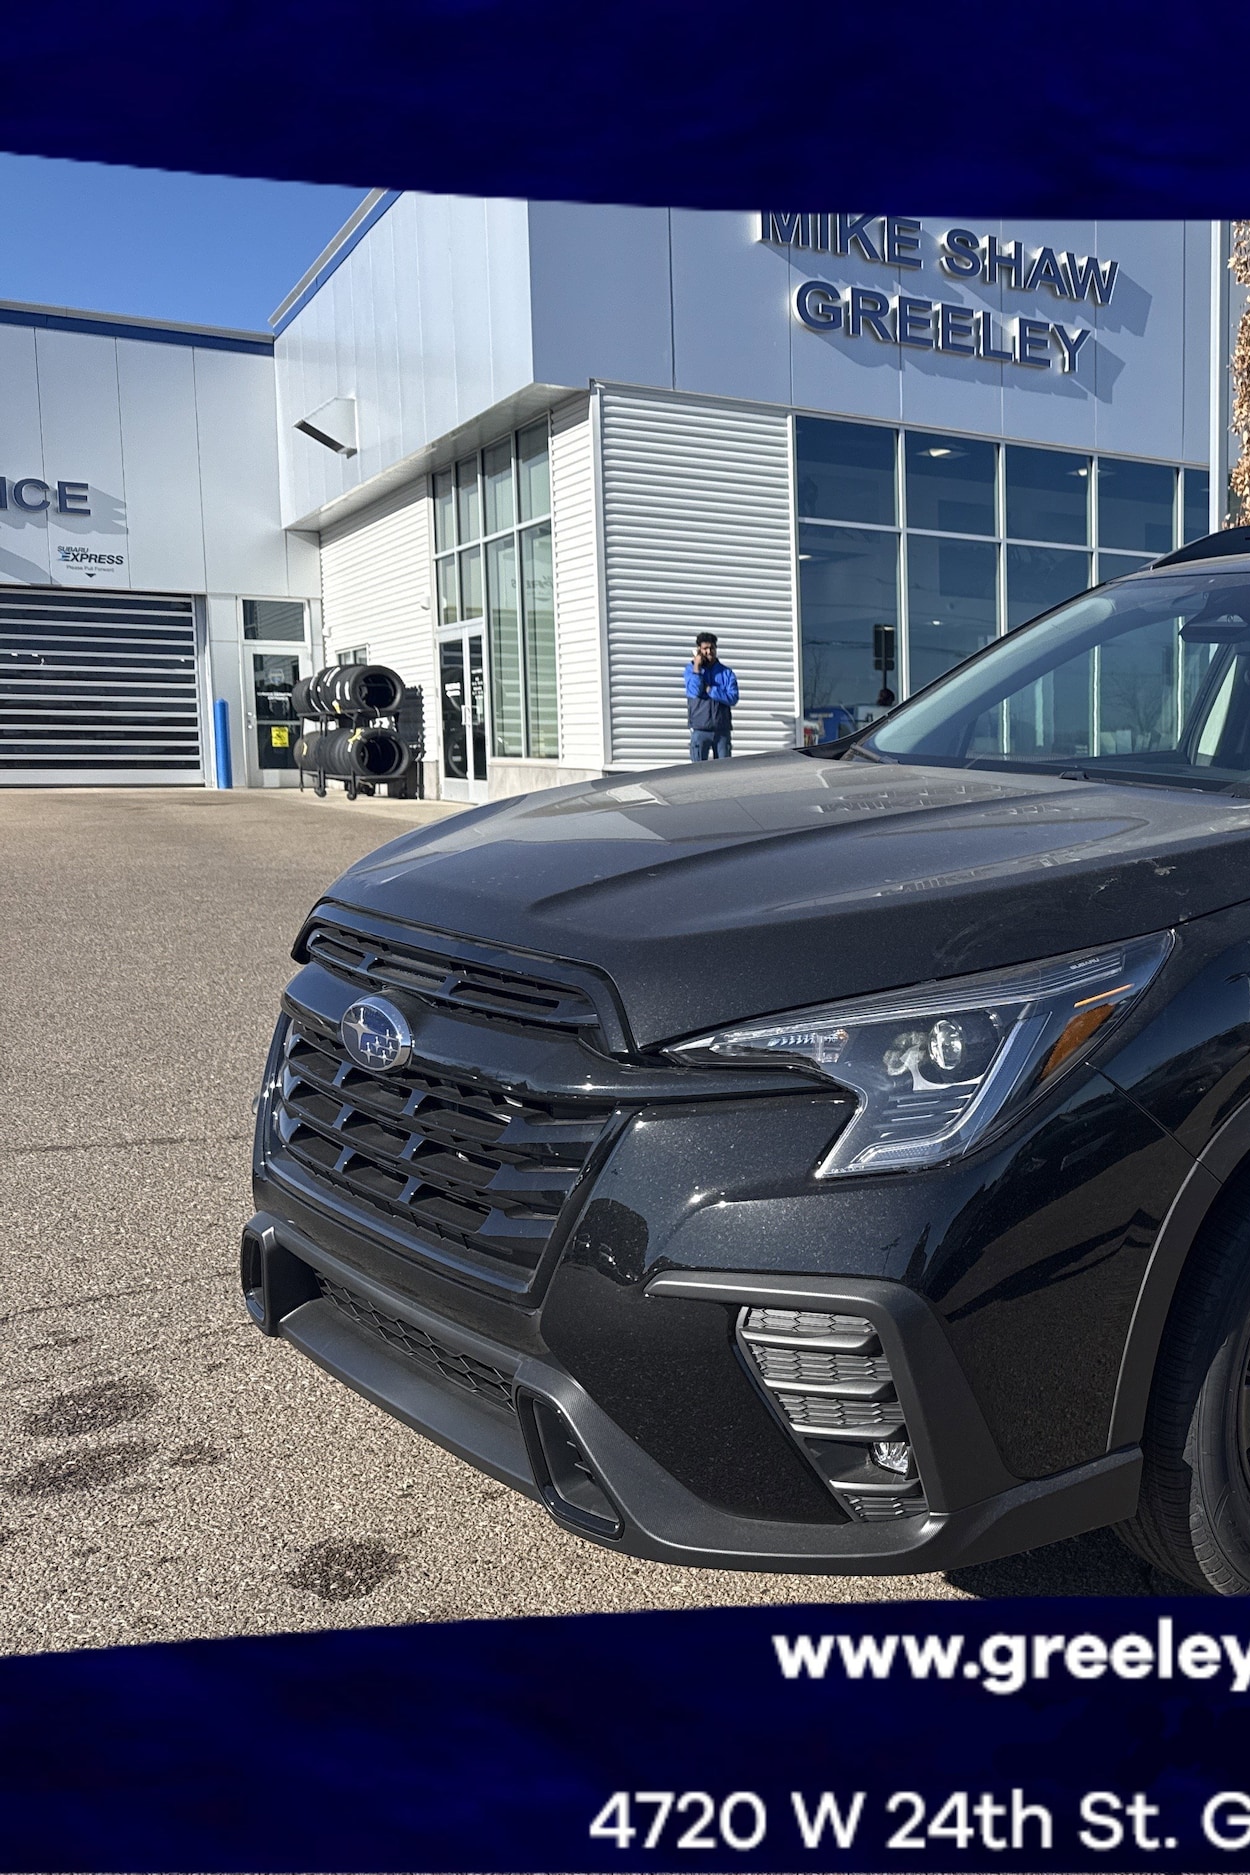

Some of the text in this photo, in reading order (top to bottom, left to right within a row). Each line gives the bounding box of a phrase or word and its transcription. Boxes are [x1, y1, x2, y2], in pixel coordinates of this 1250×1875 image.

[758, 210, 1120, 305] MIKE SHAW
[794, 279, 1092, 373] GREELEY
[57, 545, 89, 554] SUBARU
[59, 551, 124, 565] EXPRESS
